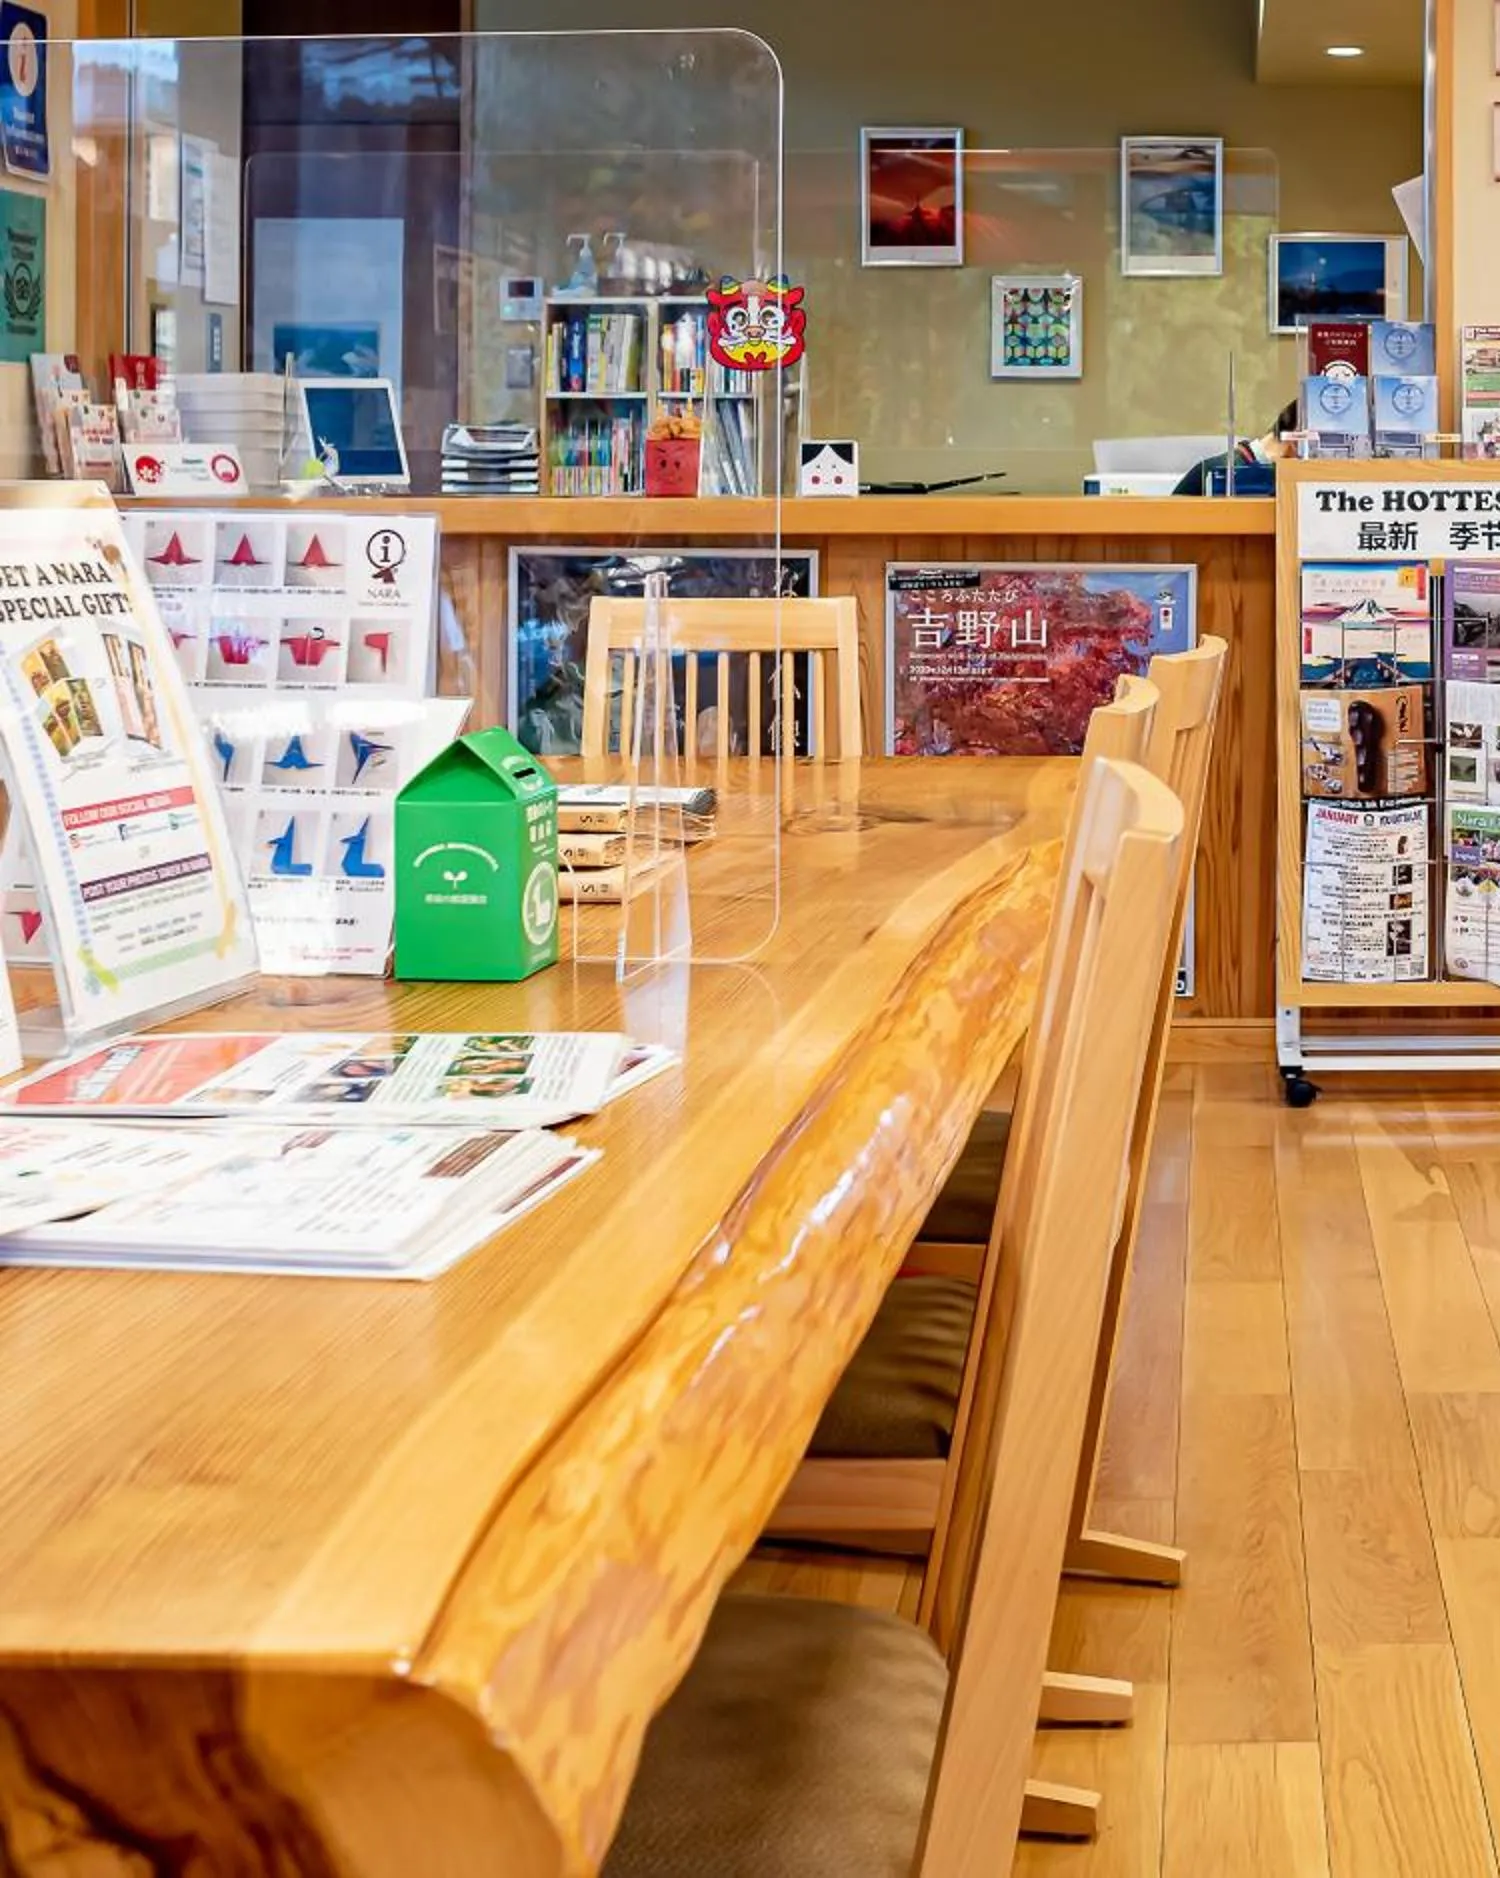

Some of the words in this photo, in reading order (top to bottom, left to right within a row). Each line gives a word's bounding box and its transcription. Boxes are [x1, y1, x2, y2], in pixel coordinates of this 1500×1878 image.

[1315, 489, 1375, 512] The
[1357, 521, 1419, 552] 最新
[36, 563, 53, 585] A
[50, 561, 113, 584] NARA
[909, 588, 1020, 604] こころふたたび
[906, 606, 1049, 649] 吉野山
